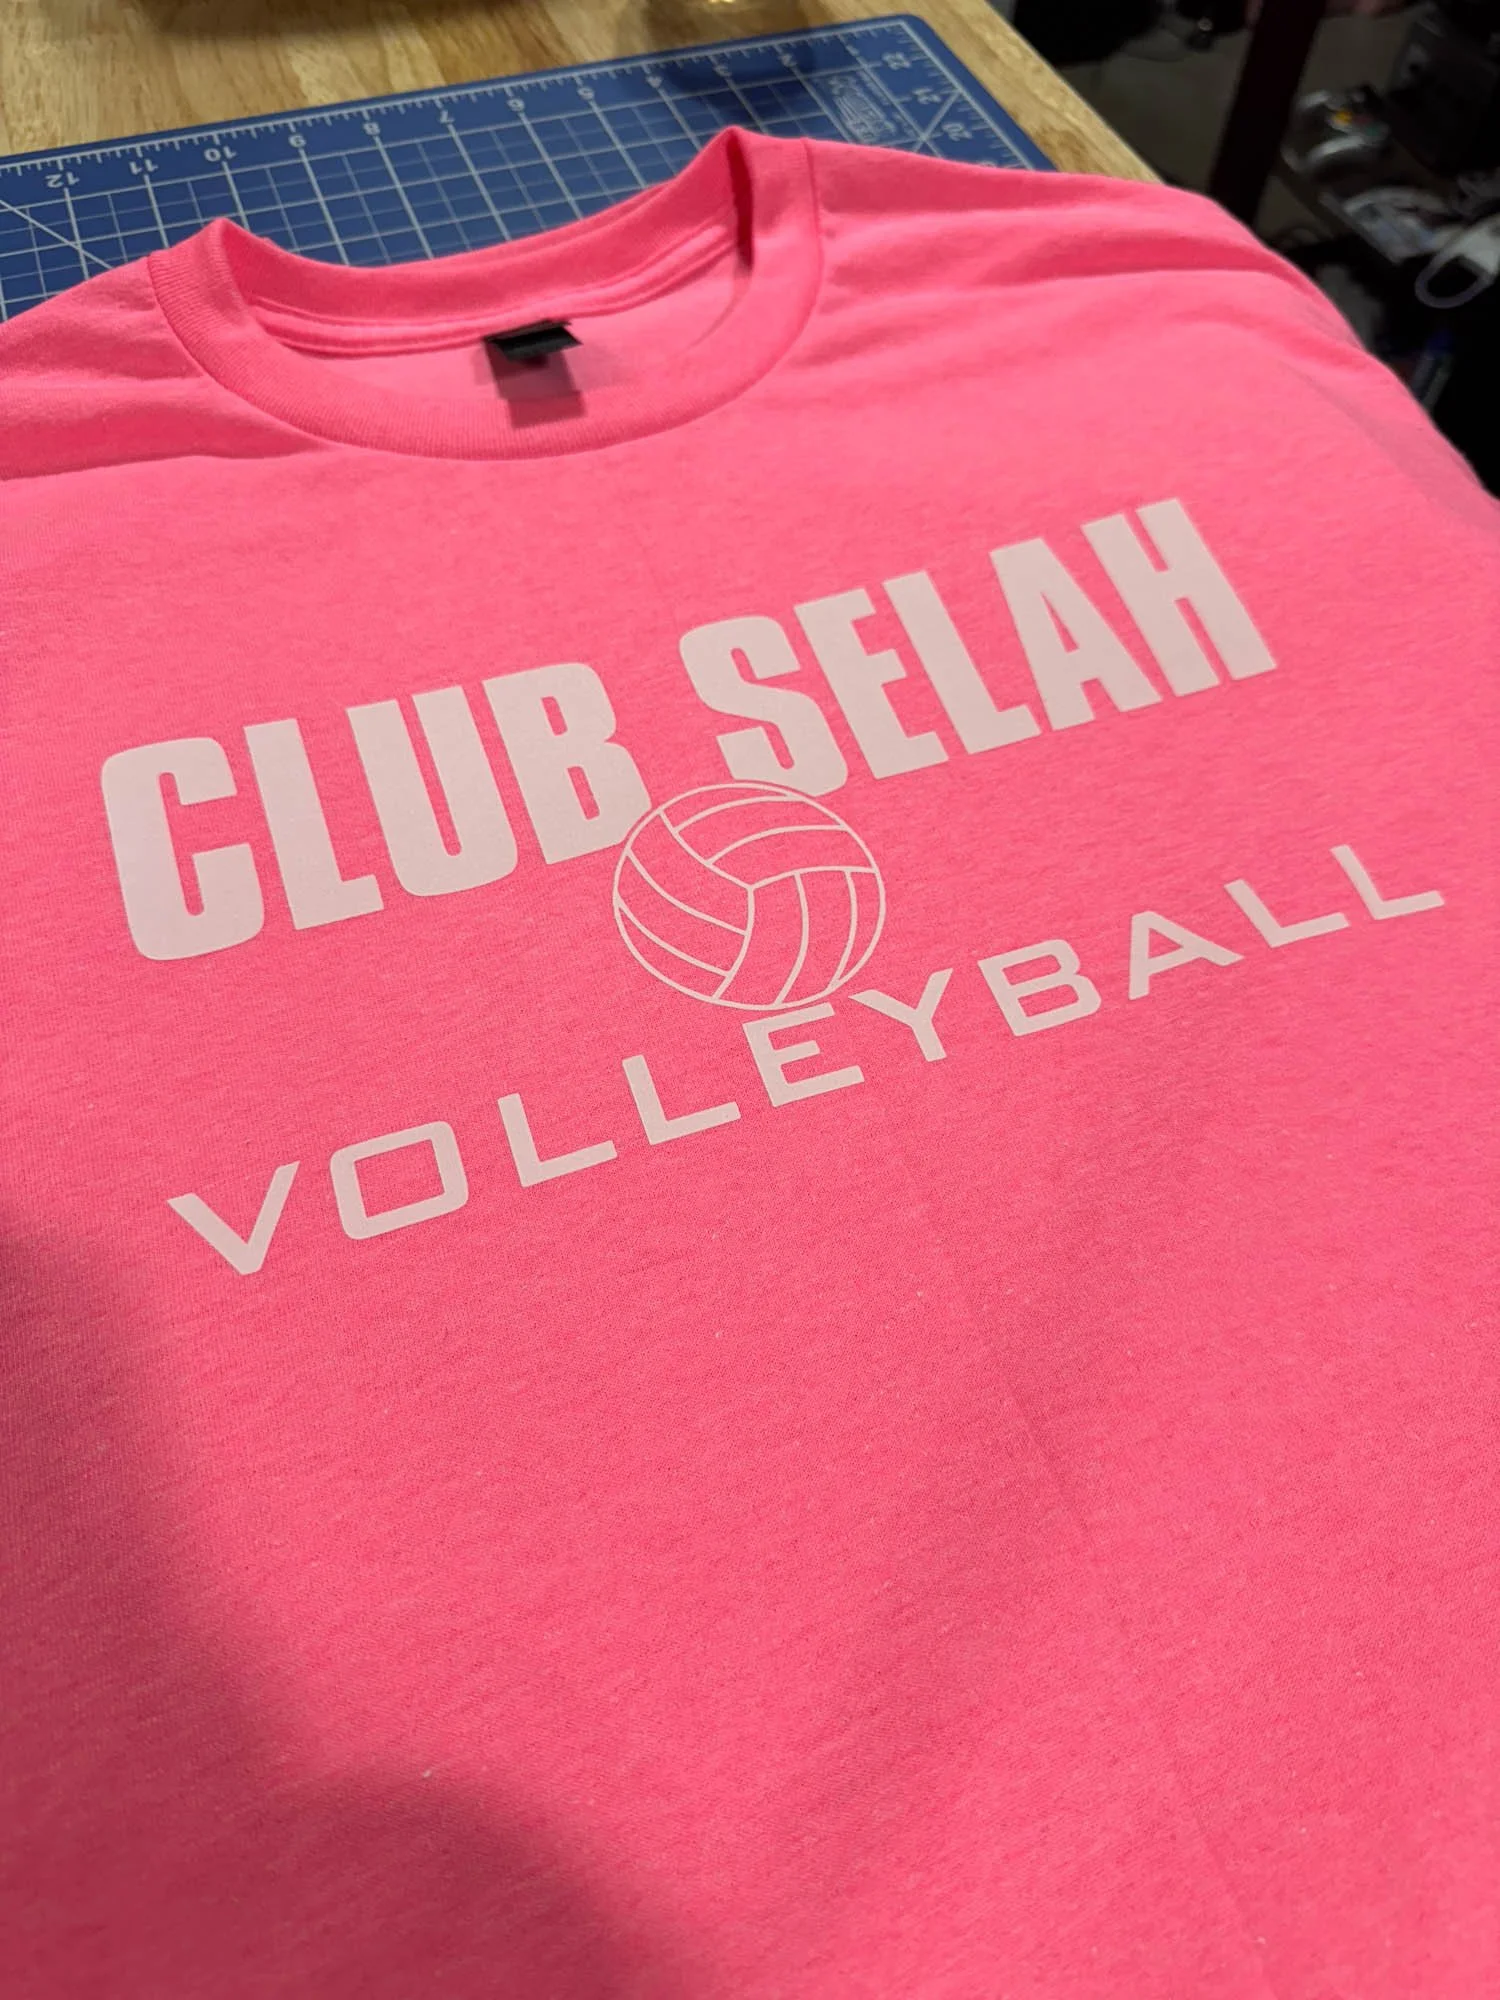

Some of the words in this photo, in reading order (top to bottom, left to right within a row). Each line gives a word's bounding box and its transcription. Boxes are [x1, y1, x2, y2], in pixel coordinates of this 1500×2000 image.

[507, 98, 524, 113] 6
[440, 110, 456, 124] 7
[363, 122, 381, 136] 8
[288, 133, 306, 148] 9
[204, 146, 237, 162] 10
[130, 160, 158, 176] 11
[46, 173, 80, 188] 12
[101, 662, 650, 961] CLUB
[679, 498, 1276, 798] SELAH
[168, 844, 1444, 1275] VOLLEYBALL
